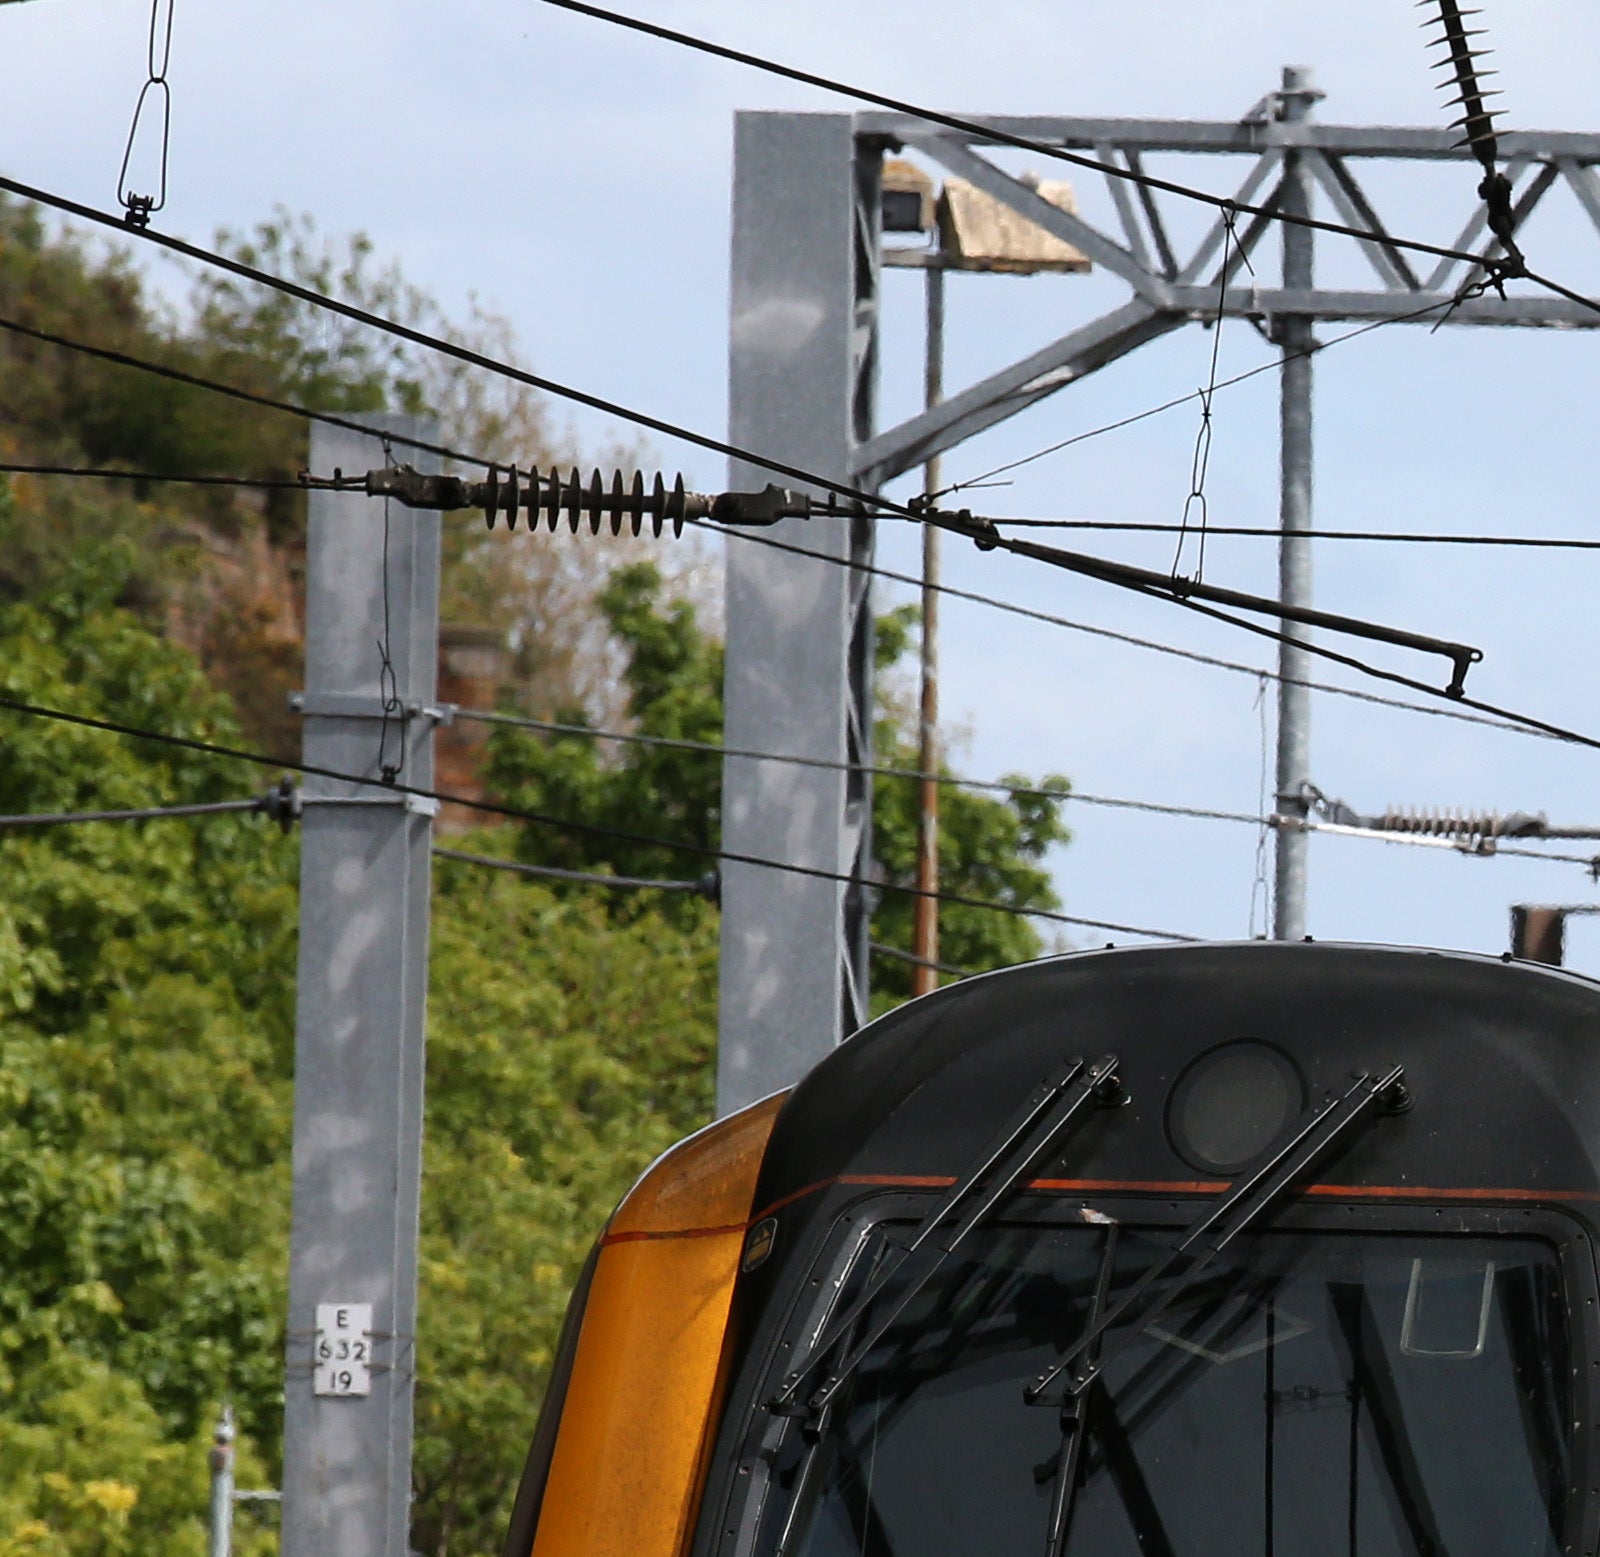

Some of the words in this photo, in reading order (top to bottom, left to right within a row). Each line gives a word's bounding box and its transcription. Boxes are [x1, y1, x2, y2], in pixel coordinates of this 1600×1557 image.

[336, 1309, 349, 1328] E
[319, 1340, 366, 1361] 632
[330, 1370, 352, 1390] 19
